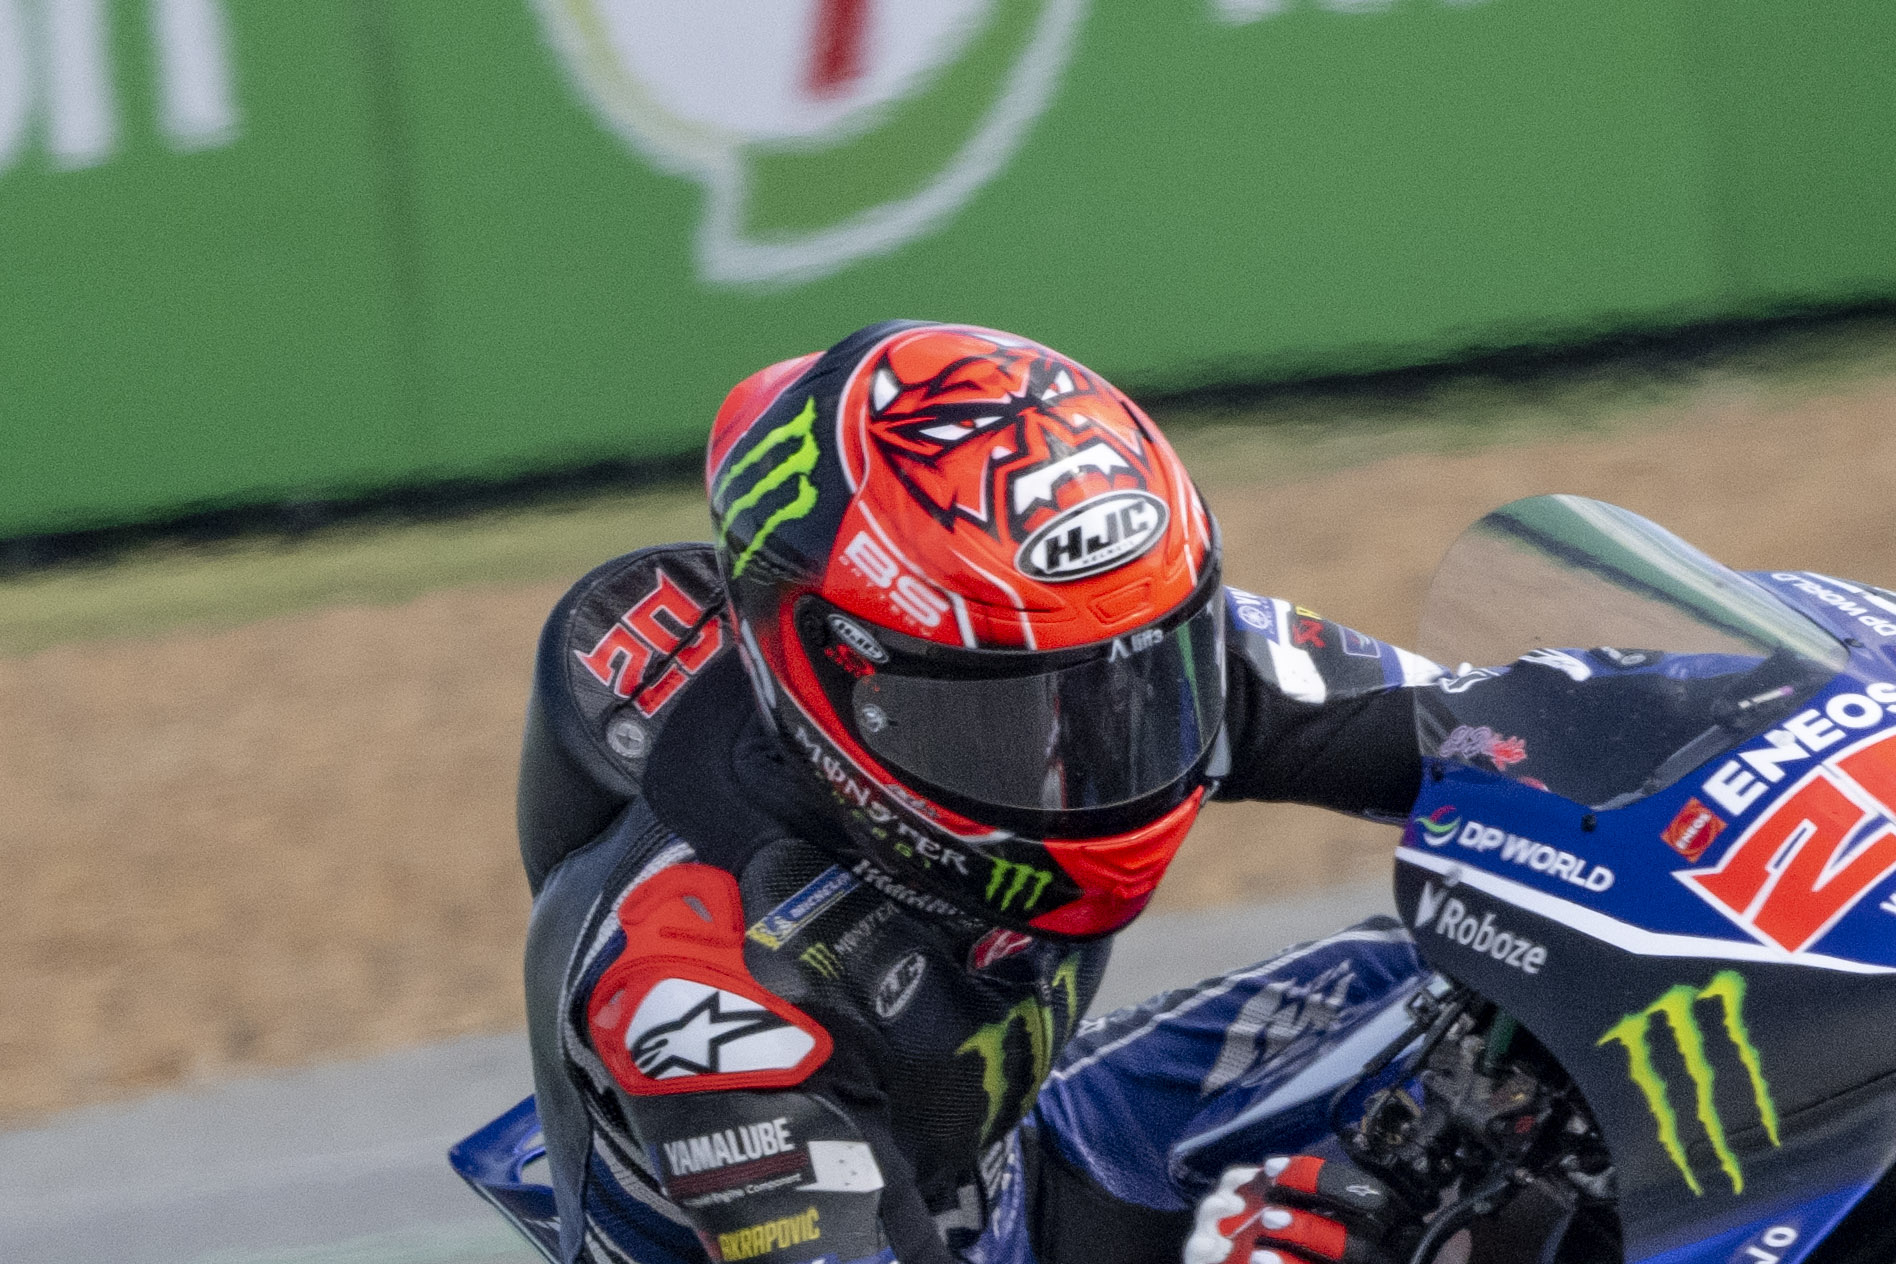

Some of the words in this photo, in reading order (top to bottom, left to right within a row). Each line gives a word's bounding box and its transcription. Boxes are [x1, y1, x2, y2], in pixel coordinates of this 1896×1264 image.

[1045, 499, 1149, 570] HJC
[844, 531, 950, 627] BS
[796, 727, 969, 875] MONSTER
[1675, 811, 1712, 852] ENEOS
[1457, 820, 1506, 852] DP
[1499, 833, 1616, 893] WORLD
[1435, 898, 1548, 975] Roboze
[663, 1117, 796, 1176] YAMALUBE
